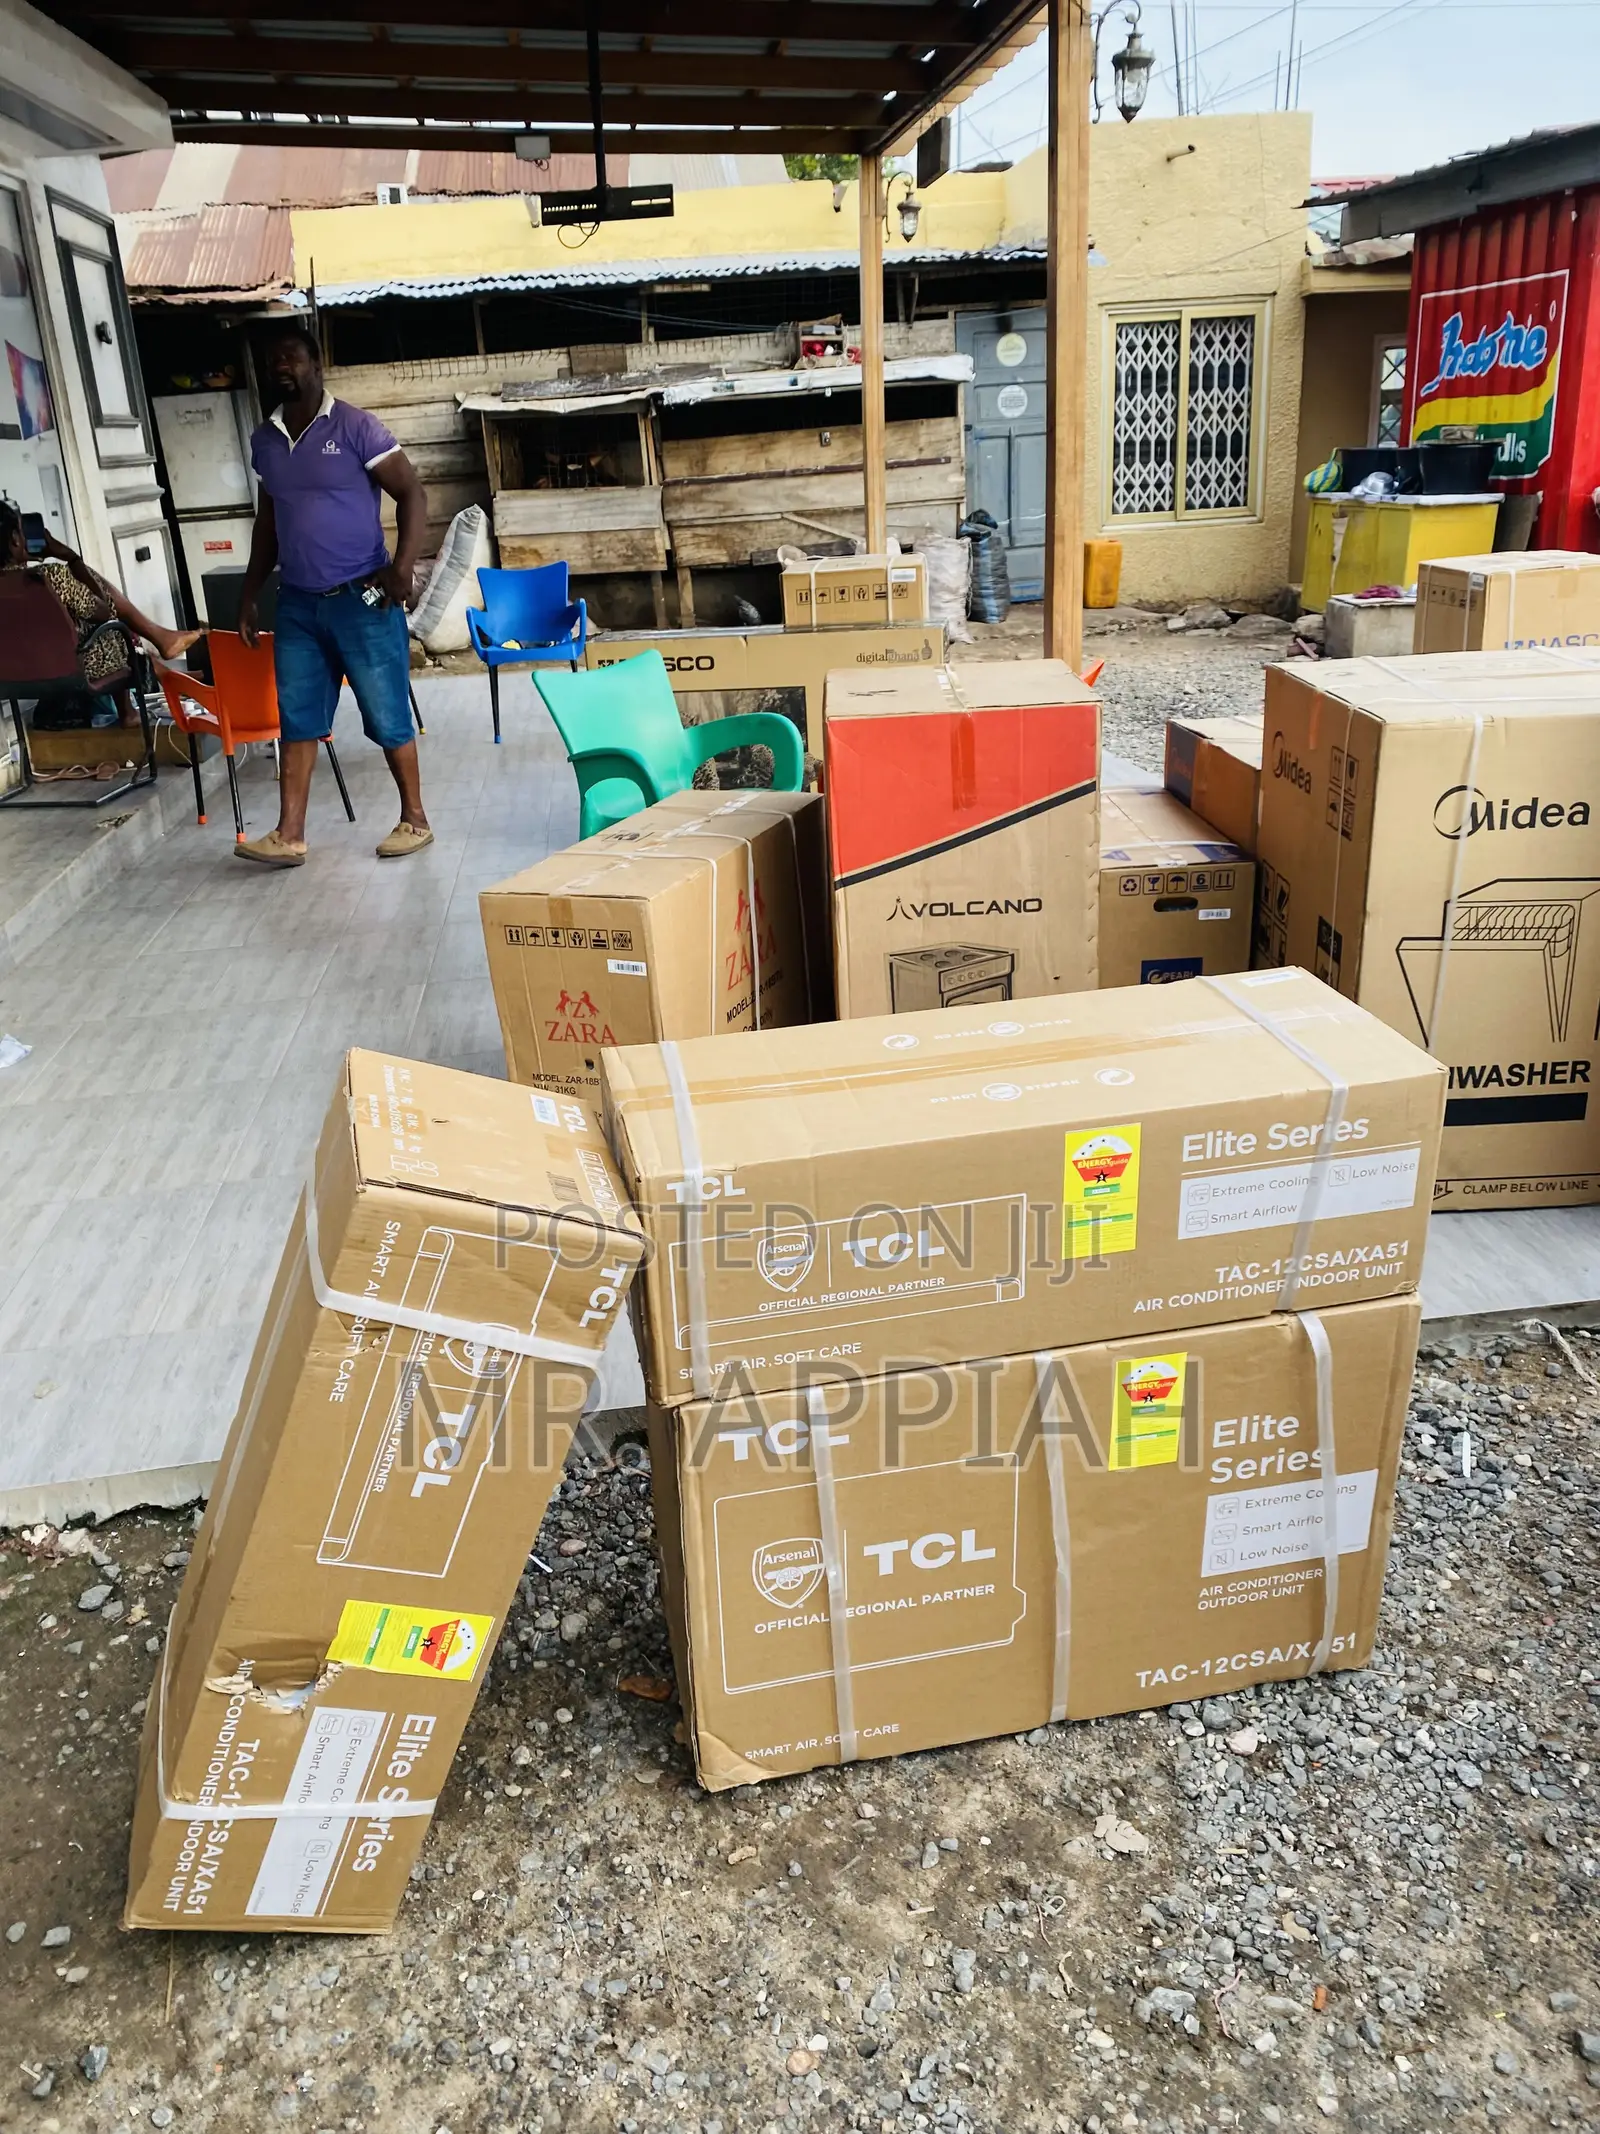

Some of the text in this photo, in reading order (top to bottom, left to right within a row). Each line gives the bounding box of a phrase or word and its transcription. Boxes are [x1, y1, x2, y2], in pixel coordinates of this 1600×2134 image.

[1528, 634, 1599, 648] NASC
[1272, 730, 1312, 796] Midea
[1433, 785, 1590, 840] Midea
[1196, 873, 1205, 884] 6
[910, 897, 1043, 917] VOLCANO
[595, 931, 601, 939] 4
[570, 1001, 586, 1019] Z
[544, 1020, 619, 1045] ZARA
[554, 1085, 577, 1095] 31KG
[565, 1075, 601, 1086] ZAR-18B
[560, 1104, 588, 1134] TCL
[1182, 1129, 1257, 1162] Elite
[1352, 1160, 1416, 1180] Low Noise
[1463, 1180, 1590, 1195] CLAMP BELOW LINE
[666, 1175, 746, 1204] TCL
[1211, 1181, 1265, 1198] Extreme
[1210, 1202, 1298, 1224] Smart Airflow
[764, 1230, 945, 1268] Arsenal TCL
[1215, 1240, 1410, 1284] TAC-12CSA/XA51
[579, 1263, 627, 1328] TCL
[759, 1277, 946, 1312] OFFICIAL REGIONAL PARTNER
[1133, 1298, 1162, 1313] AIR
[1295, 1269, 1360, 1288] NDOOR
[1364, 1261, 1404, 1277] UNIT
[329, 1220, 401, 1403] SMART AI SOFT CARE
[679, 1361, 734, 1380] SRT
[774, 1350, 816, 1367] SOFT
[819, 1342, 863, 1359] CARE
[372, 1331, 436, 1493] FICIAL REGIONAL PARTNER
[1212, 1414, 1300, 1448] Elite
[411, 1404, 477, 1498] TCL
[1210, 1447, 1324, 1484] Series
[1245, 1484, 1358, 1510] Extreme Coing
[1242, 1513, 1324, 1537] Smart Airflo
[763, 1529, 996, 1577] Arsenal TCL
[1240, 1542, 1309, 1562] Low Noise
[1197, 1584, 1305, 1611] OUTDOOR UNIT
[1199, 1568, 1323, 1598] AIR CONDITIONER
[754, 1584, 996, 1634] OFFICIAL EGIONAL PARTNER
[196, 1694, 246, 1808] CONDITIONER
[387, 1714, 437, 1778] Elite
[745, 1743, 791, 1760] SMART
[825, 1730, 860, 1745] SOT
[863, 1723, 900, 1738] CARE
[298, 1736, 330, 1804] Smart Airflo
[319, 1738, 362, 1830] Extreme Cong
[177, 1817, 206, 1872] NDOOR
[163, 1876, 188, 1912] UNIT
[291, 1859, 319, 1914] Low Noise
